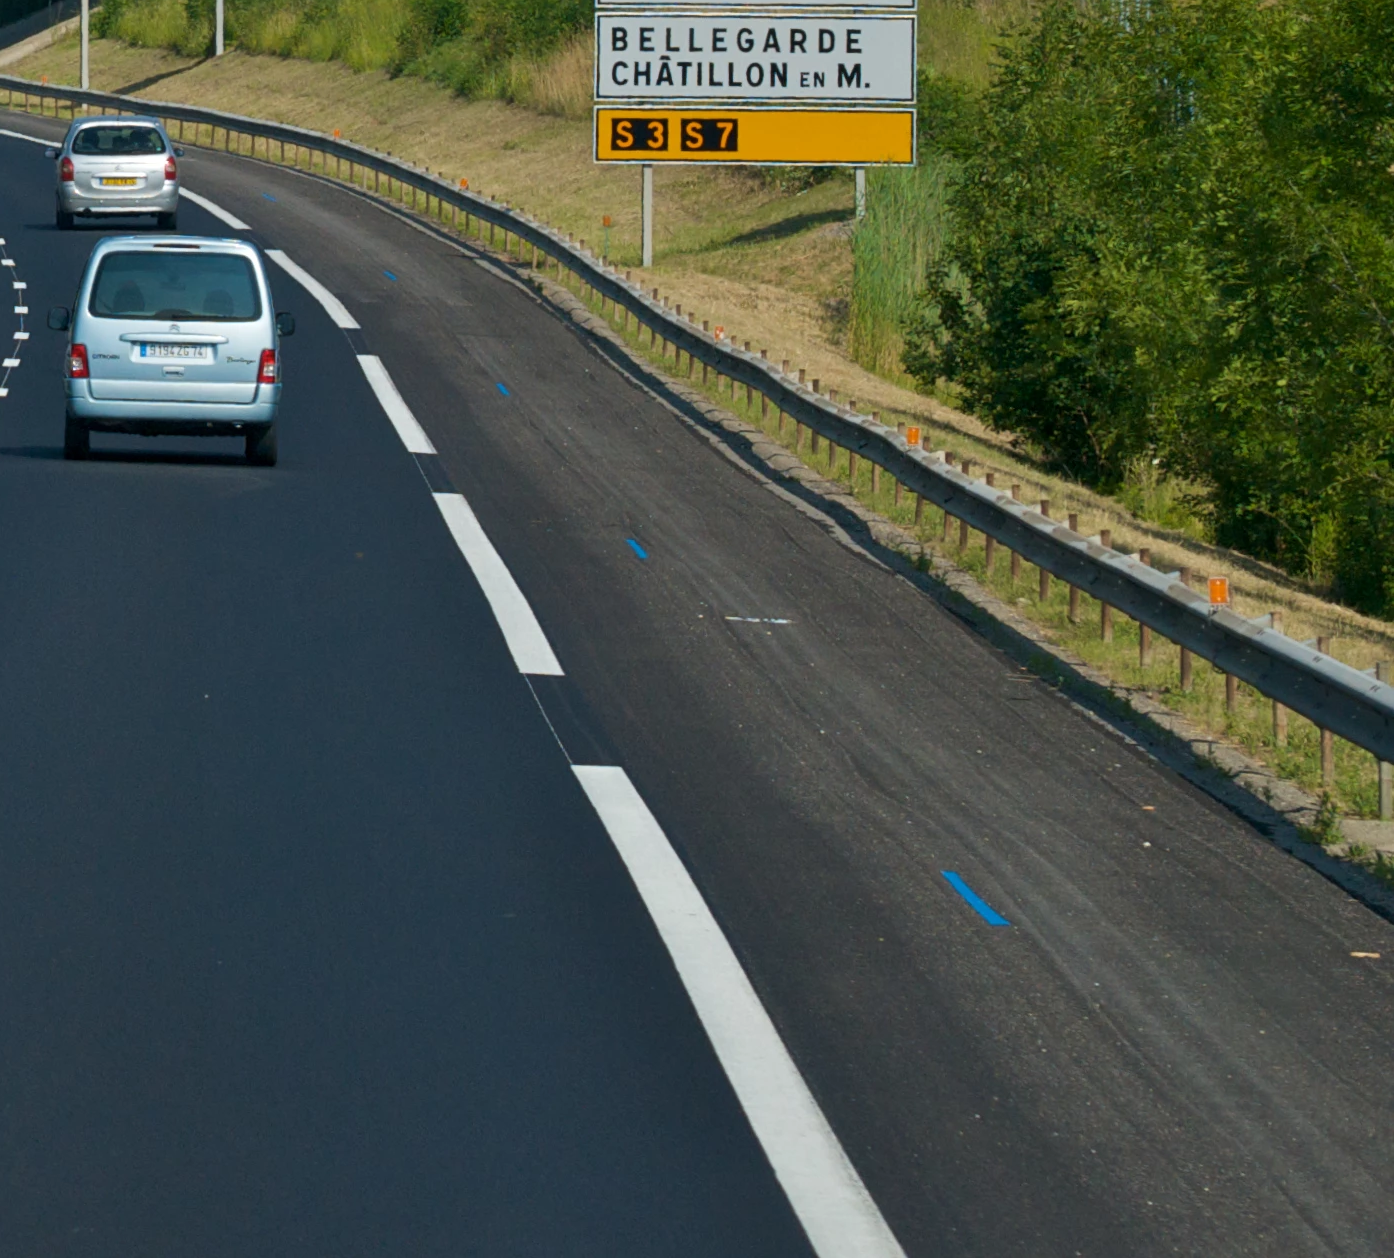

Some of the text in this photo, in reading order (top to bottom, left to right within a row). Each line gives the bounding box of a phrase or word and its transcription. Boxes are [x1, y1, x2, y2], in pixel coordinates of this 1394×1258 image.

[611, 26, 863, 54] BELLEGARDE
[611, 55, 871, 89] CHÂTILLON EN M.
